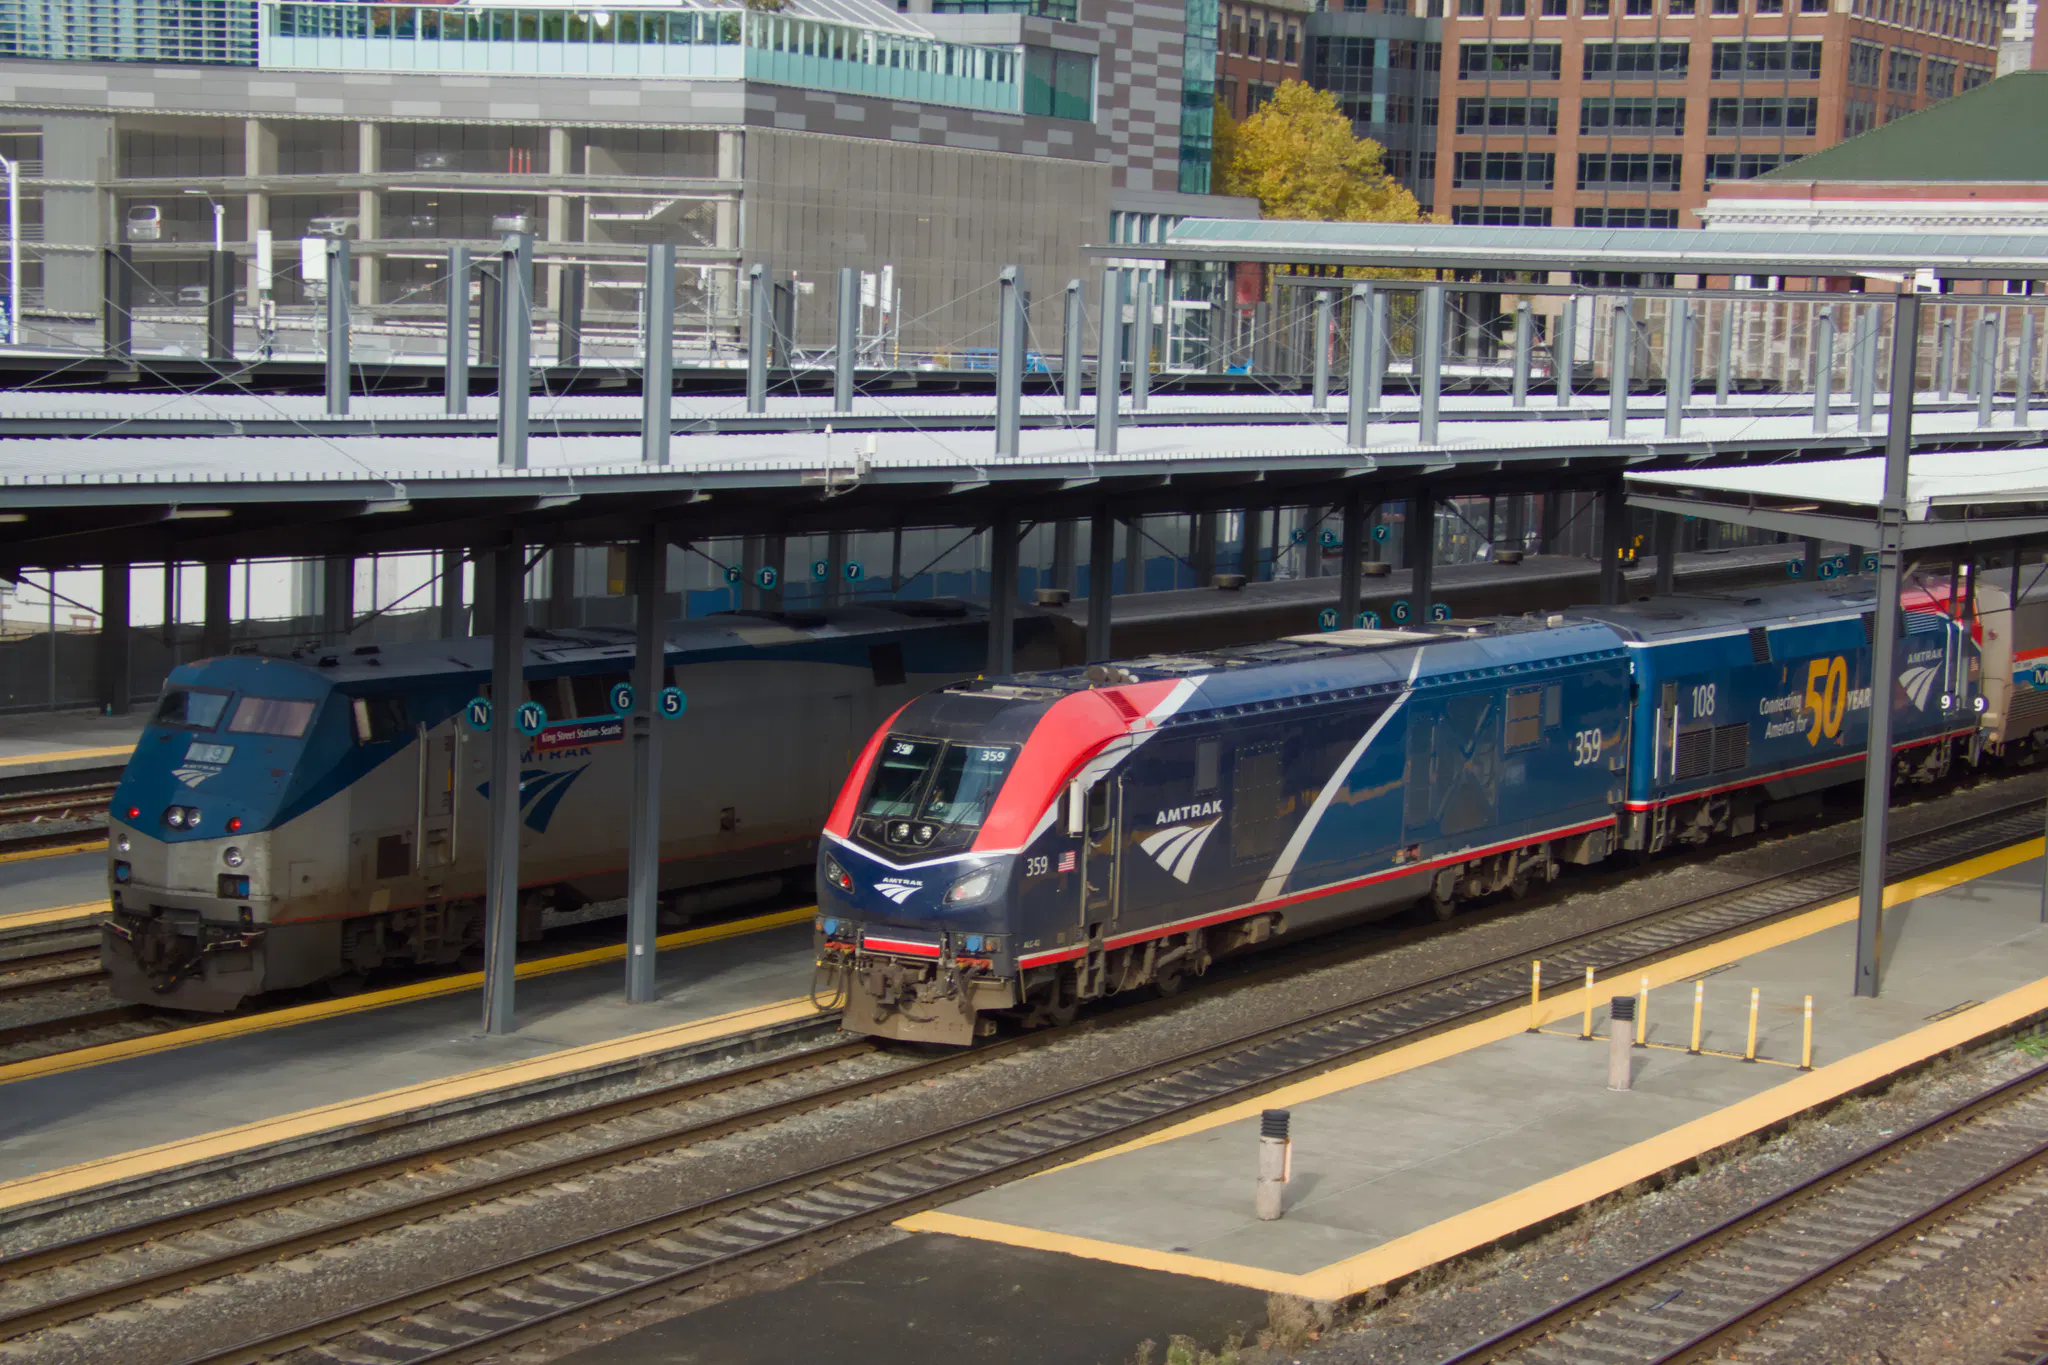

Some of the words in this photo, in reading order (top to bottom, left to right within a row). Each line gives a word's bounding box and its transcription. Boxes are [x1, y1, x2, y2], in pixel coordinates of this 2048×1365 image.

[817, 563, 825, 575] 8
[850, 565, 857, 577] 7
[1792, 563, 1799, 574] L
[1824, 565, 1832, 576] L
[1867, 560, 1876, 570] 5
[763, 572, 772, 584] F
[1396, 605, 1406, 619] 6
[1434, 608, 1445, 621] 5
[1323, 613, 1336, 627] M
[1362, 617, 1375, 629] M
[1907, 648, 1943, 665] AMTRAK
[618, 690, 630, 708] 6
[666, 694, 678, 712] 5
[1692, 683, 1715, 717] 108
[1760, 691, 1803, 715] Connecting
[1805, 656, 1848, 747] 50
[1941, 695, 1951, 709] 9
[1974, 697, 1984, 711] 9
[474, 705, 488, 724] N
[524, 710, 538, 729] N
[1765, 718, 1795, 739] America
[1796, 714, 1808, 732] for
[541, 733, 556, 744] King
[557, 730, 576, 741] Street
[1574, 728, 1601, 766] 359
[980, 750, 1006, 762] 359
[1155, 799, 1223, 826] AMTRAK
[1026, 856, 1048, 877] 359
[882, 876, 923, 886] AMTRAK
